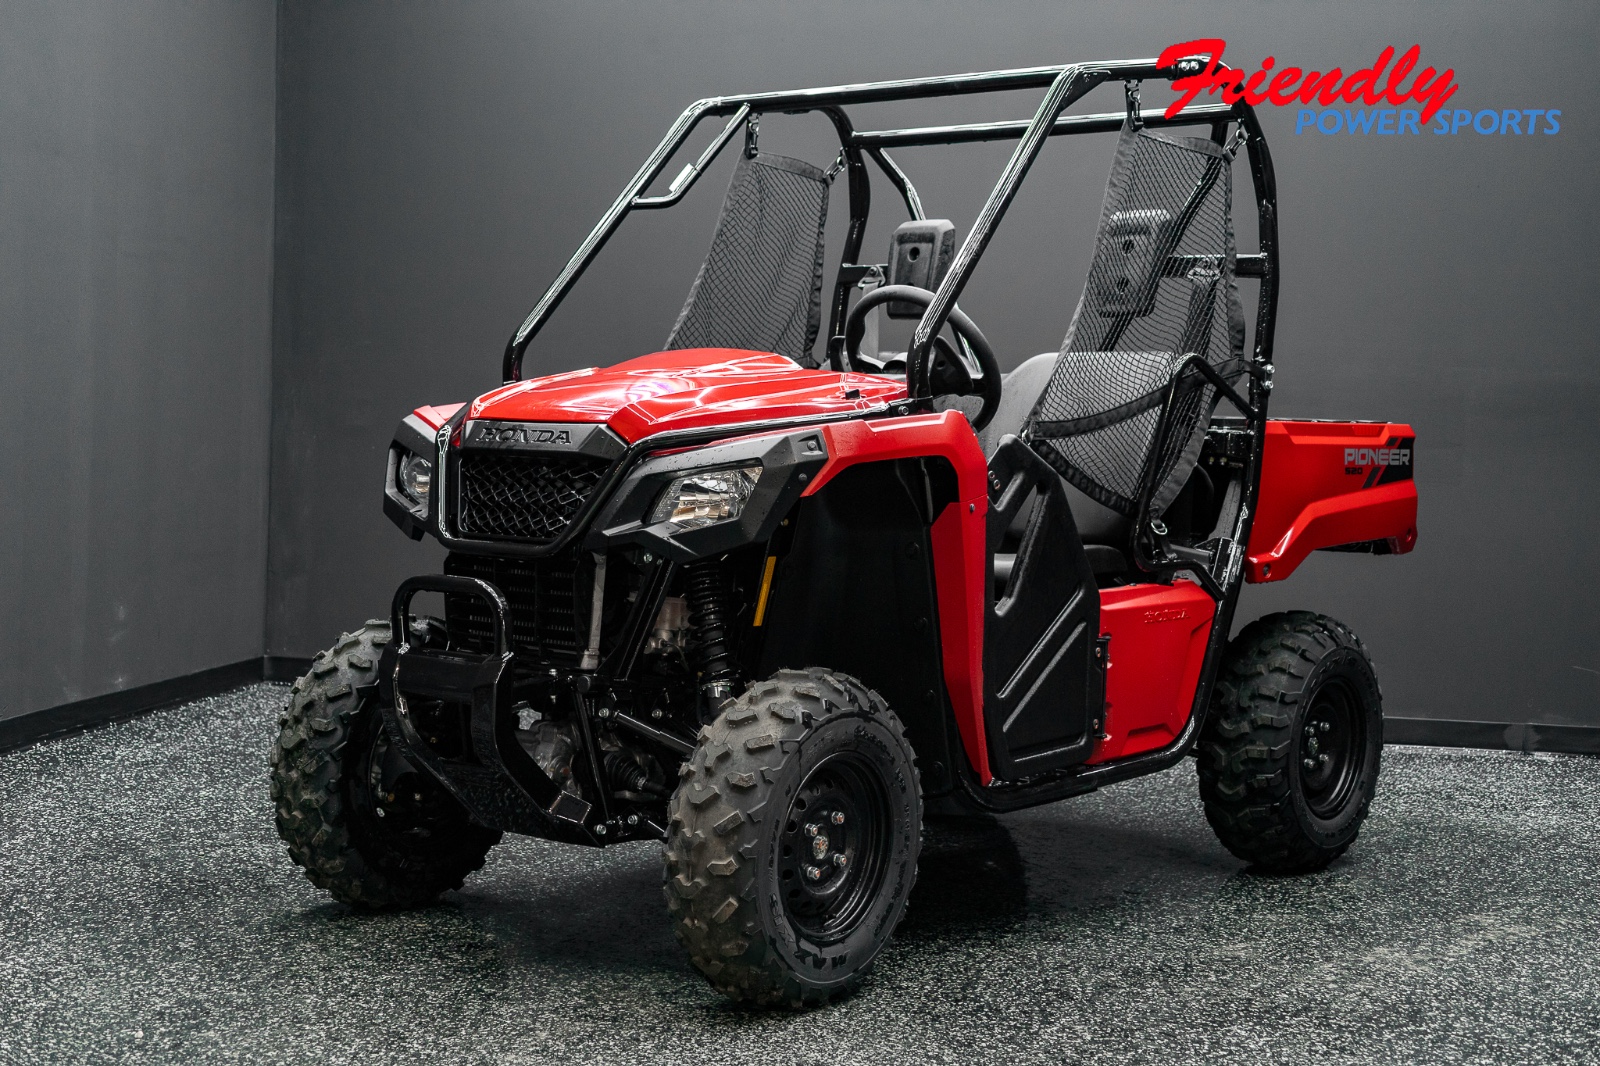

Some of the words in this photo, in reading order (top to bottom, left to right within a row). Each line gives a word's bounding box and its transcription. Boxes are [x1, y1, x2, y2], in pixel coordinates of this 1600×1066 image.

[476, 427, 572, 445] HONDA
[1344, 448, 1411, 466] PIONEER
[1345, 467, 1363, 475] 520
